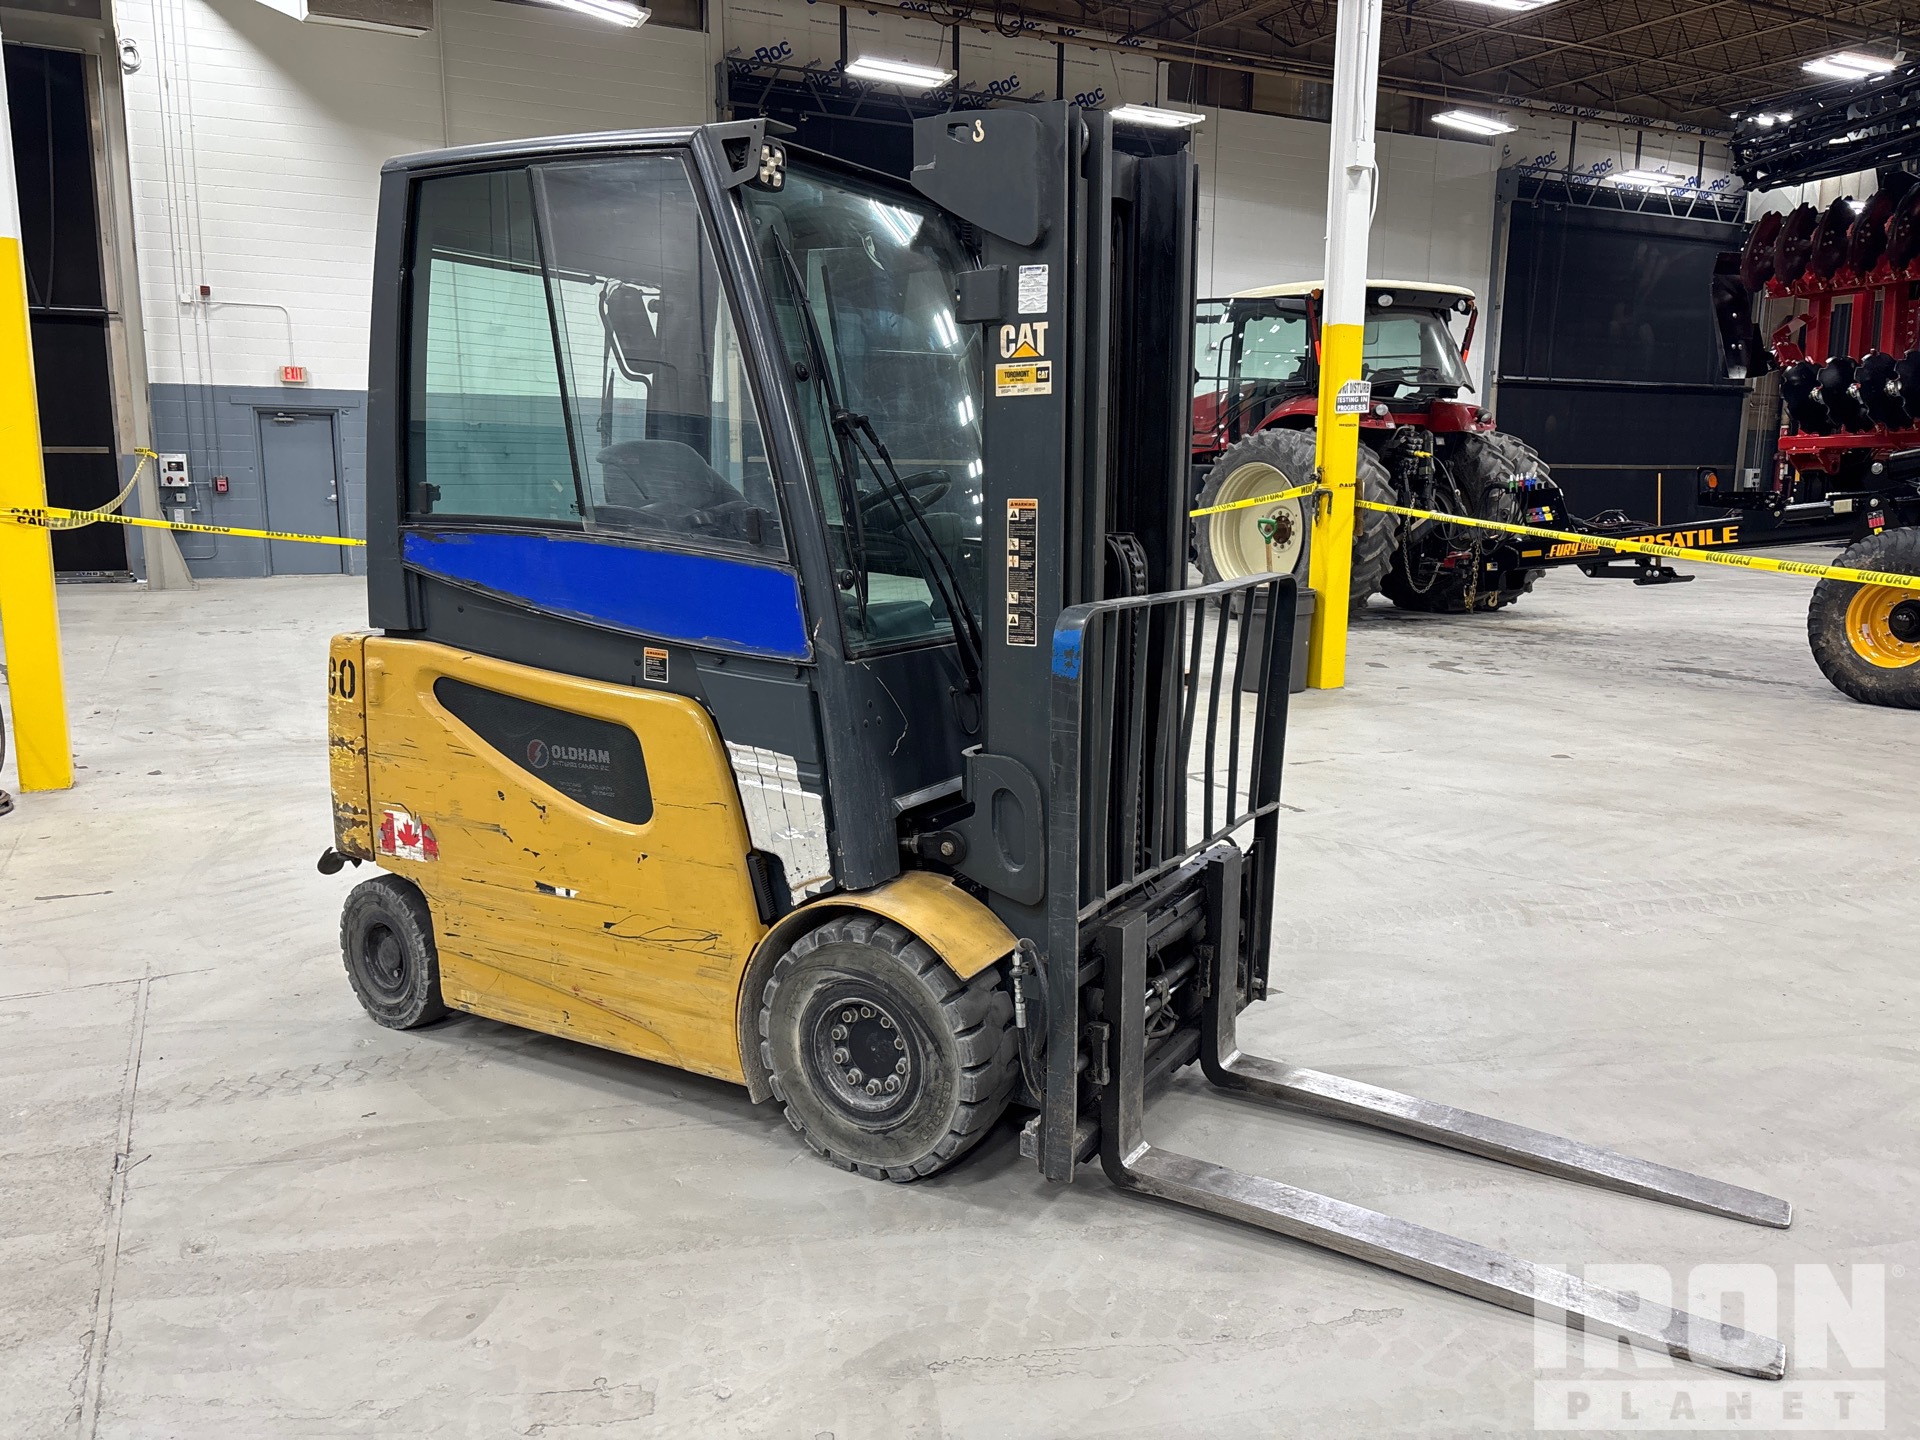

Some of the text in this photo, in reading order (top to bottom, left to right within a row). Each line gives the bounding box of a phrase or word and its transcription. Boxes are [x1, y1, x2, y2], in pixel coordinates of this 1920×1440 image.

[1000, 321, 1049, 359] CAT
[284, 366, 303, 380] EXIT
[1037, 370, 1049, 379] CAT
[1549, 542, 1579, 557] FURY
[551, 744, 611, 764] OLDHAM
